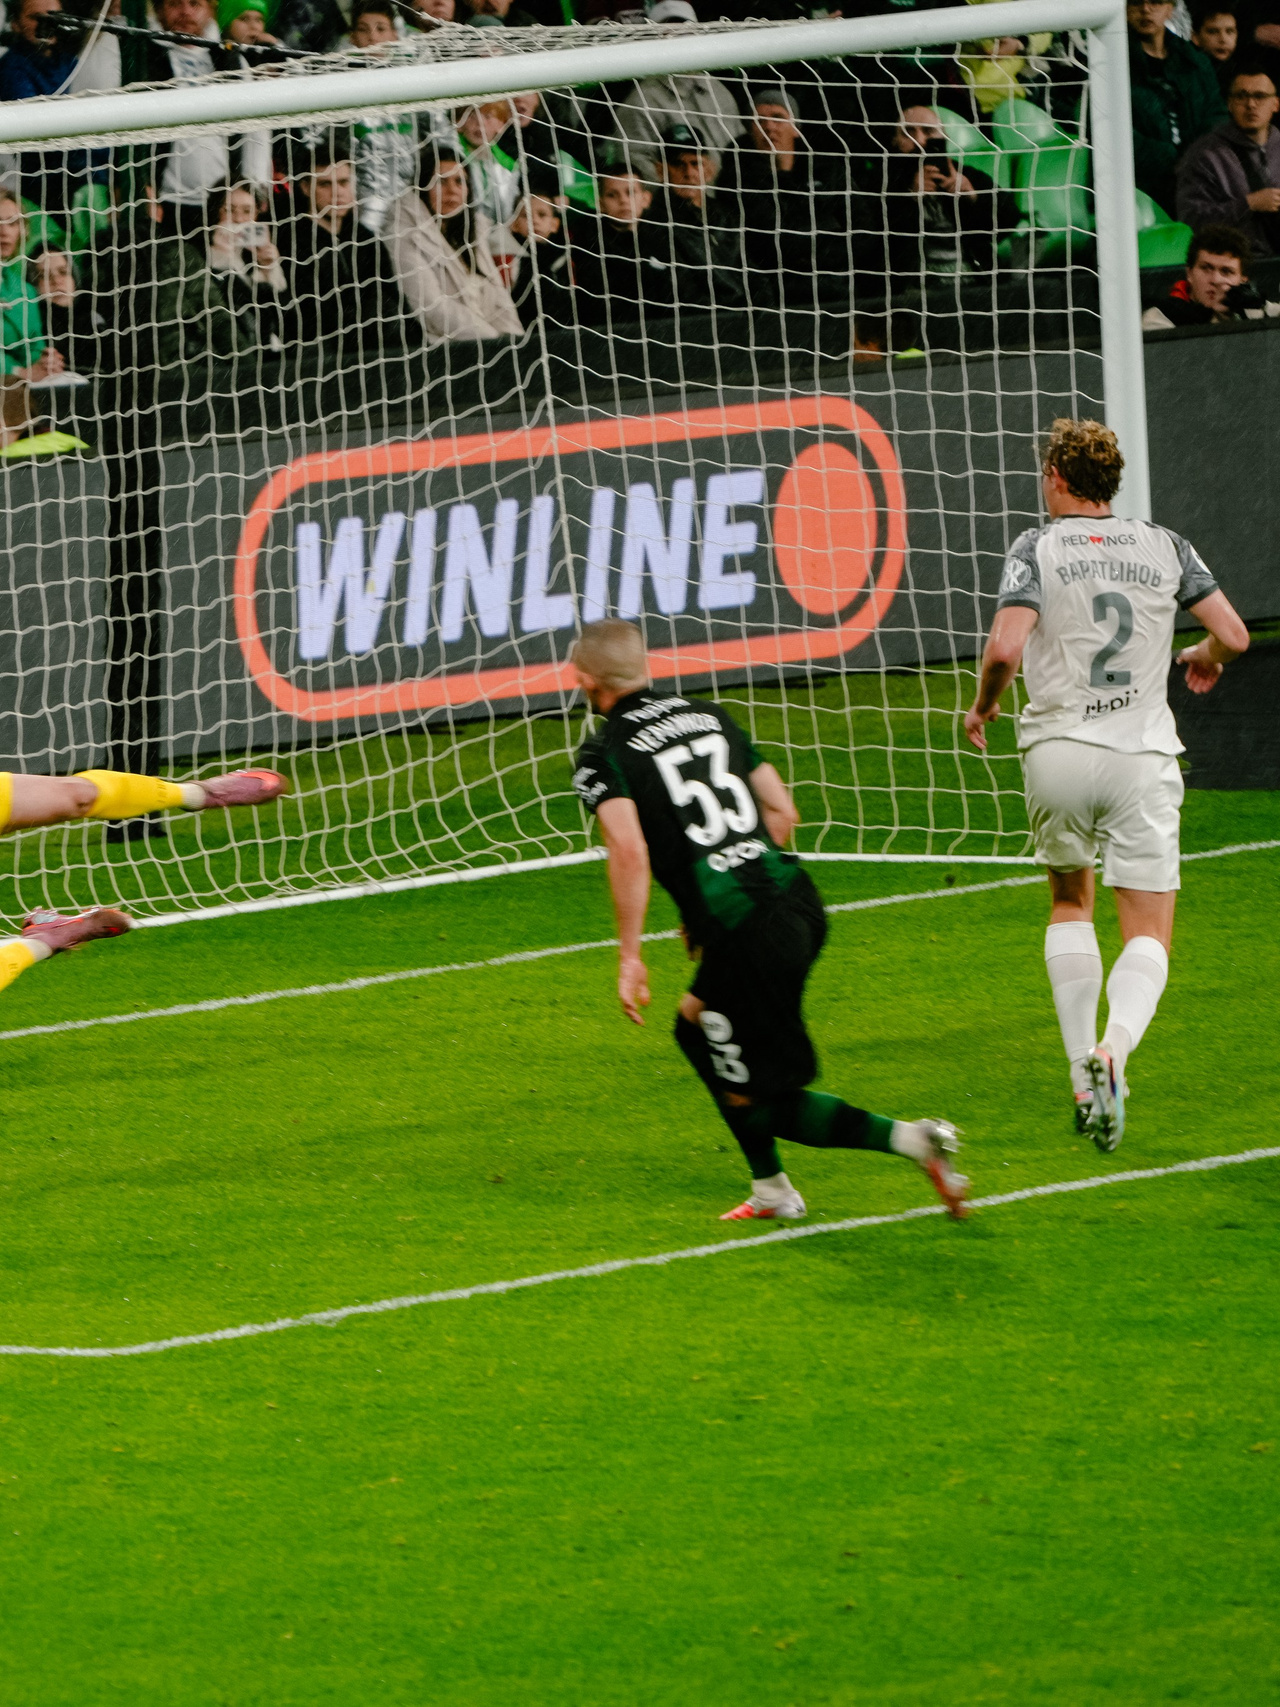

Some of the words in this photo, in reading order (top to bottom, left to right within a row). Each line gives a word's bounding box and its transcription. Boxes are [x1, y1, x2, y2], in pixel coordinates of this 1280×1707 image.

[295, 468, 765, 660] WINLINE
[1089, 591, 1134, 688] 2
[652, 733, 759, 848] 53
